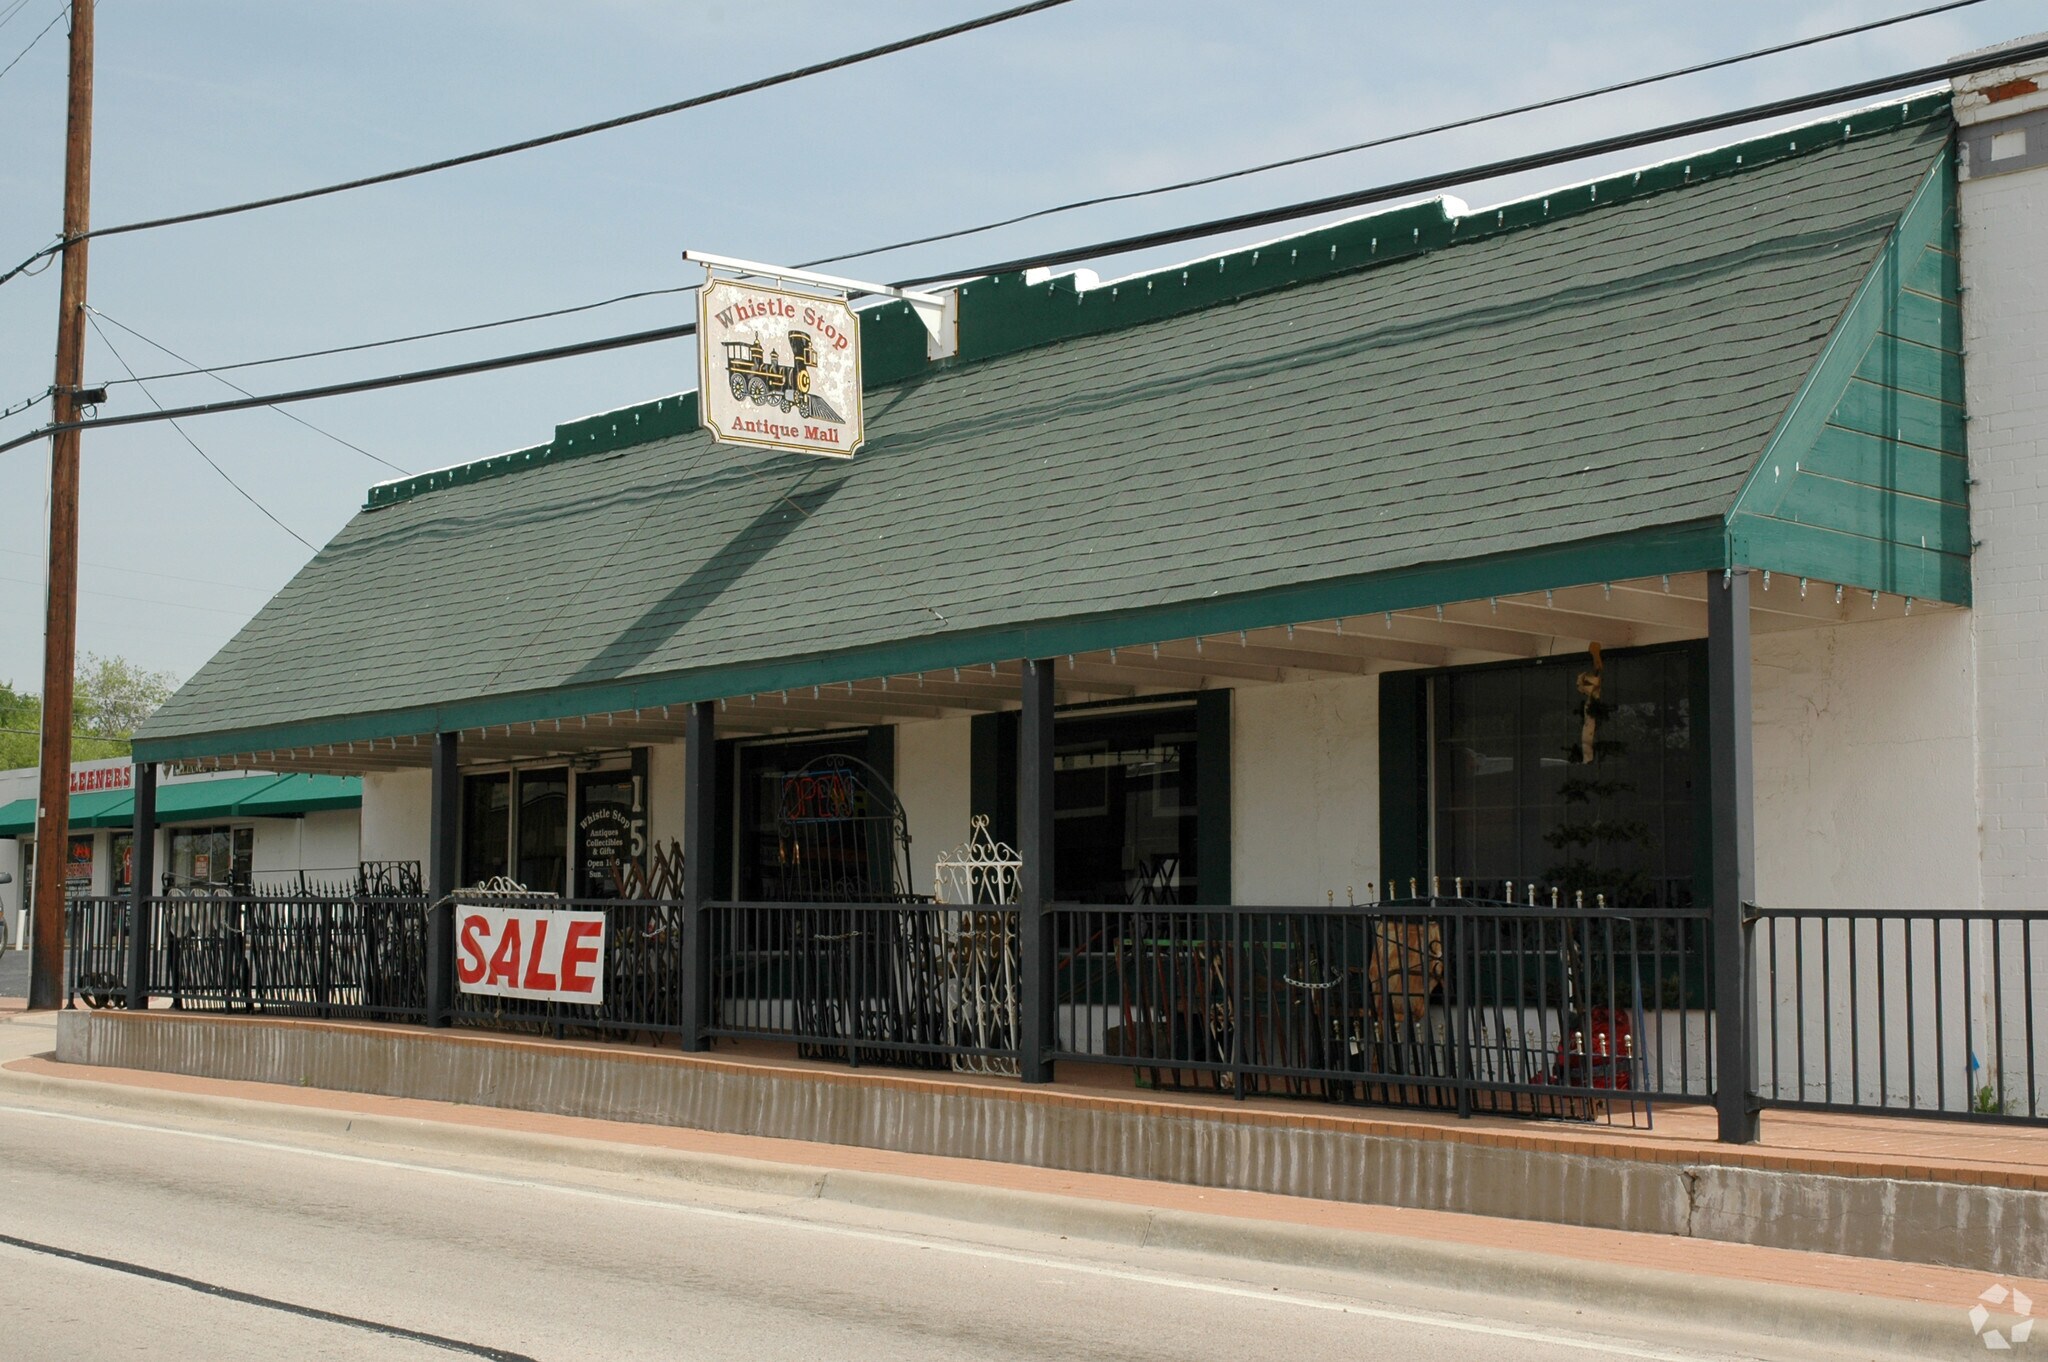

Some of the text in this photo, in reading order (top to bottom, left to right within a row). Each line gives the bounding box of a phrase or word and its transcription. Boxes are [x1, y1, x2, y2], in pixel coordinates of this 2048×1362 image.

[715, 298, 849, 351] Whistle Stop
[731, 416, 840, 444] Antique Mall
[70, 766, 131, 792] LEANERS
[784, 773, 852, 819] OPEN
[580, 808, 631, 830] Whistle Stop
[586, 838, 623, 848] Collectibles
[589, 829, 619, 838] Antiques
[592, 846, 615, 856] & Gifts
[587, 859, 604, 868] Open
[456, 914, 604, 994] SALE
